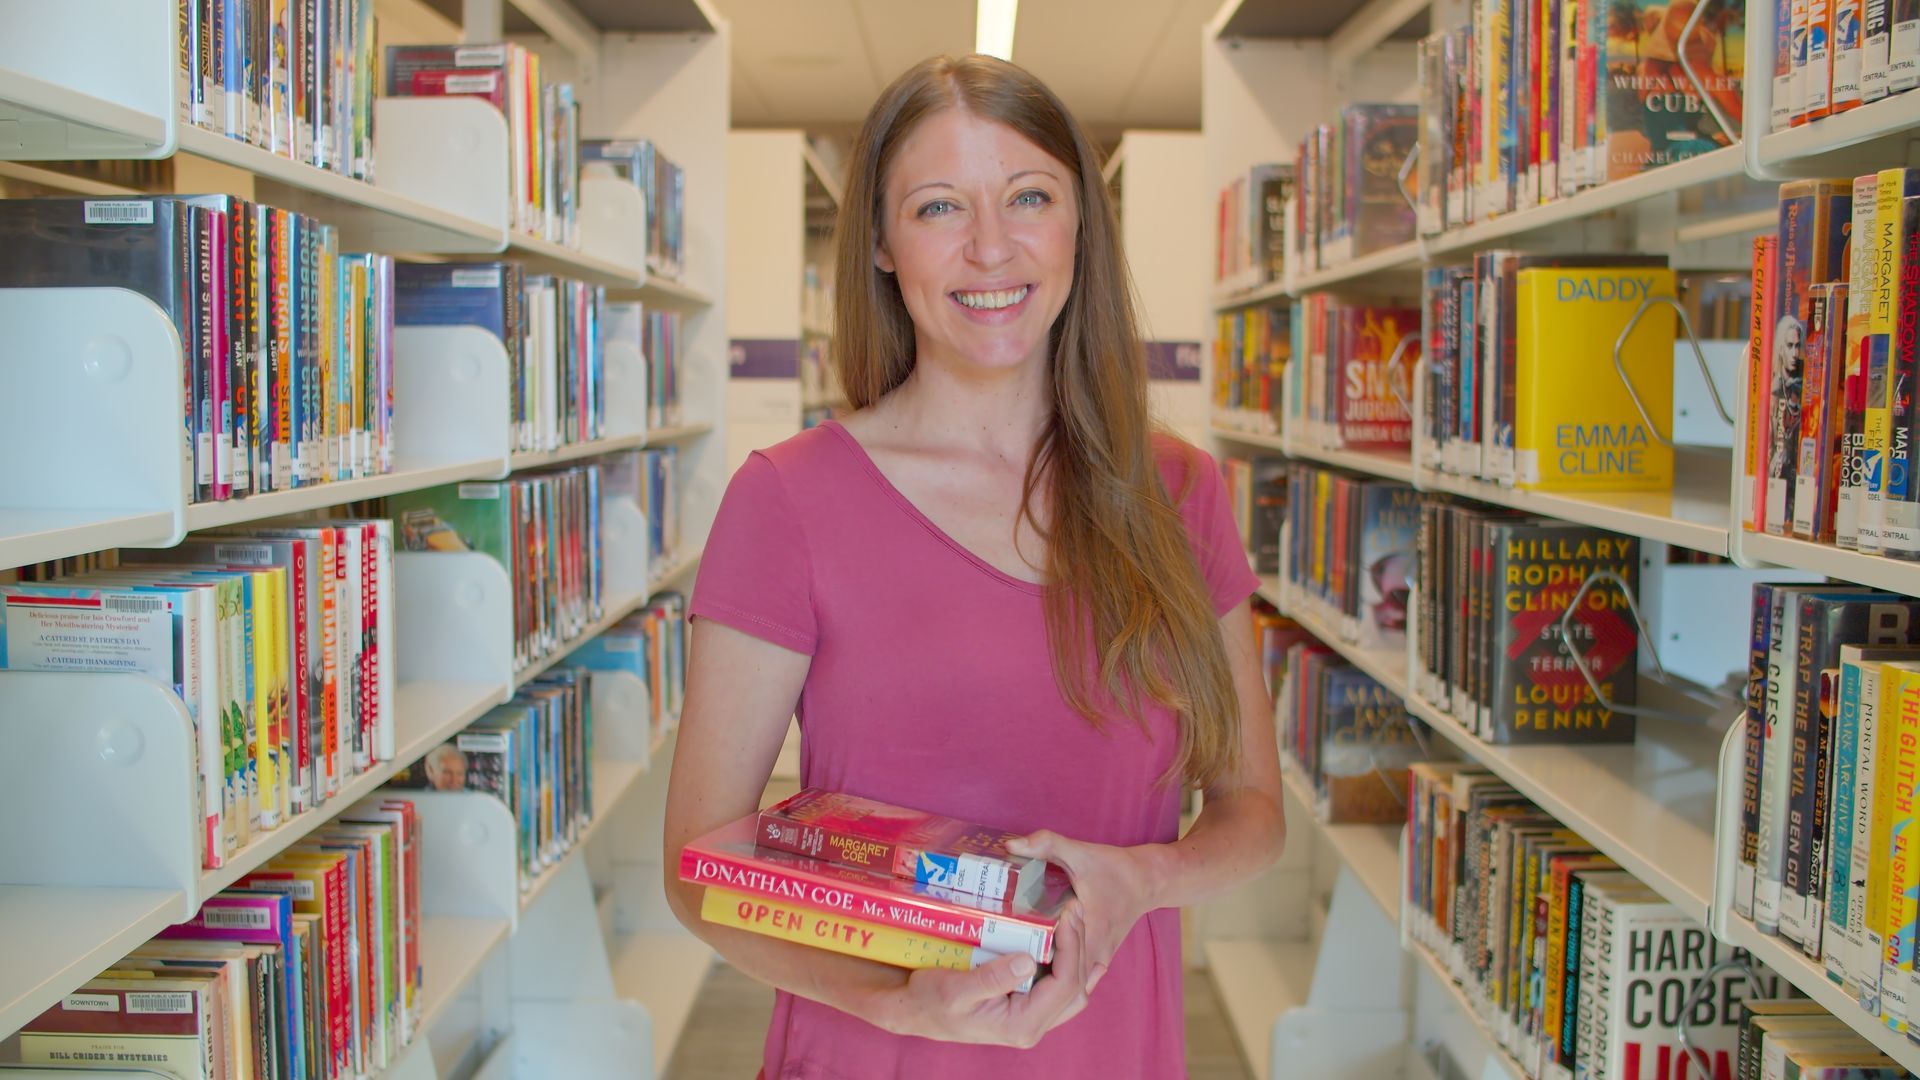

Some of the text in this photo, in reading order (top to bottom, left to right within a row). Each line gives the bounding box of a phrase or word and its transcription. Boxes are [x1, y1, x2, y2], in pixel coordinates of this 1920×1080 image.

[1613, 76, 1666, 90] WHEN
[1645, 92, 1708, 113] CUB
[1612, 152, 1673, 165] CHANEL
[233, 202, 245, 321] ROBERT
[279, 219, 289, 276] ROBERT
[201, 229, 212, 360] THIRD STRIKE
[300, 229, 310, 333] ROBERT
[310, 231, 319, 334] ROBERT
[1557, 277, 1655, 302] DADDY
[1878, 222, 1894, 323] MARGARET
[277, 281, 291, 354] CRAIS
[1754, 268, 1765, 331] CHARM
[1902, 264, 1920, 363] SHADOW
[234, 340, 244, 368] MAN
[270, 339, 278, 373] LIGHT
[1556, 424, 1648, 449] EMMA
[1558, 450, 1645, 475] CLINE
[1507, 538, 1631, 561] HILLARY
[296, 554, 306, 624] OTHER
[1506, 564, 1629, 587] RODHAM
[29, 611, 59, 620] Delicious
[60, 613, 80, 622] praise
[80, 613, 91, 621] for
[105, 615, 136, 623] Crawford
[40, 620, 53, 628] Her
[54, 621, 104, 630] Mouthwatering
[1505, 590, 1629, 613] CLINTON
[45, 634, 78, 642] CATERED
[89, 636, 126, 644] PATRICK'S
[1540, 624, 1594, 641] STTE
[1771, 605, 1785, 653] BEN
[1799, 623, 1813, 674] TRAP
[52, 657, 84, 665] CATERED
[85, 658, 136, 667] THANKSGIVING
[298, 628, 308, 697] WIDOW
[1514, 684, 1614, 706] LOUISE
[1744, 616, 1766, 817] THE LAST REFUGE
[1766, 662, 1781, 727] COES
[1795, 690, 1809, 732] THE
[1902, 686, 1920, 728] THE
[1514, 708, 1613, 731] PENNY
[1819, 720, 1828, 732] J.
[1842, 701, 1855, 751] DARK
[1860, 702, 1873, 776] MORTAL
[1791, 736, 1807, 798] DEVIL
[1818, 739, 1828, 755] M.
[1814, 757, 1827, 829] COETZEE
[1838, 755, 1852, 834] ARCHIVE
[1895, 733, 1917, 815] GLITCH
[1858, 782, 1870, 835] WORD
[829, 835, 889, 858] MARGARET
[841, 849, 871, 864] COEL
[1789, 810, 1804, 857] BEN
[693, 859, 805, 900] JONATHAN
[810, 885, 854, 911] COE
[861, 901, 886, 919] Mr.
[887, 905, 936, 930] Wilder
[937, 916, 965, 936] and
[957, 868, 967, 887] COEL
[1890, 834, 1908, 930] ELISABETH
[736, 900, 876, 948] OPEN CITY
[1597, 906, 1614, 1001] HARLAN
[1628, 929, 1763, 972] HARLA
[70, 999, 110, 1007] DOWNTOWN
[1576, 893, 1598, 1066] HARLAN COBEN
[1625, 977, 1779, 1030] COBEN
[49, 1051, 169, 1062] BILL CRIDER'S MYSTERIES
